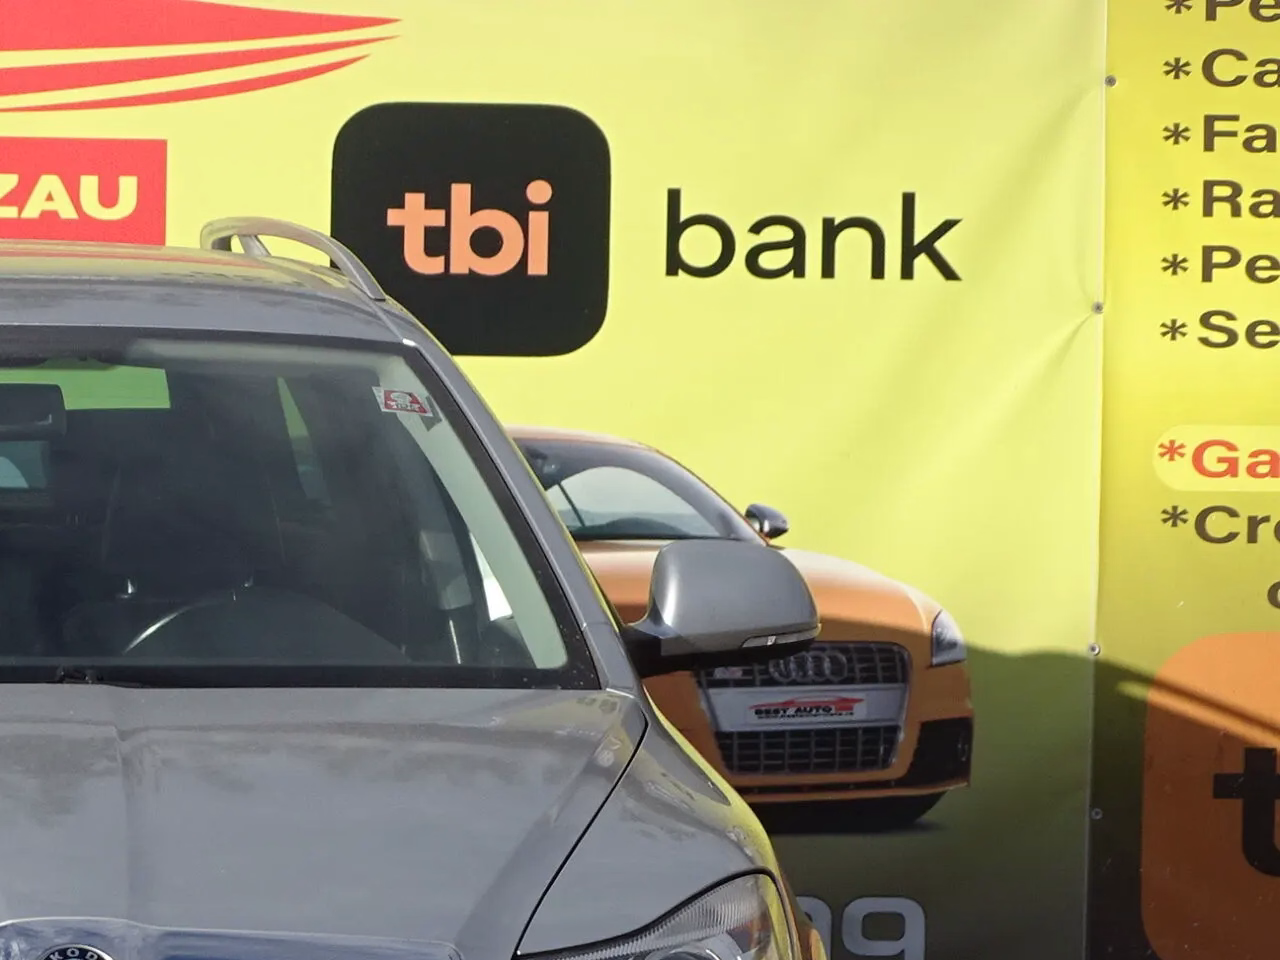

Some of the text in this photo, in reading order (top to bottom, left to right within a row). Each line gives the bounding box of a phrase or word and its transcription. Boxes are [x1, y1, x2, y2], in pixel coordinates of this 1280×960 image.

[386, 179, 963, 282] tbi bank
[1161, 505, 1280, 544] Cr
